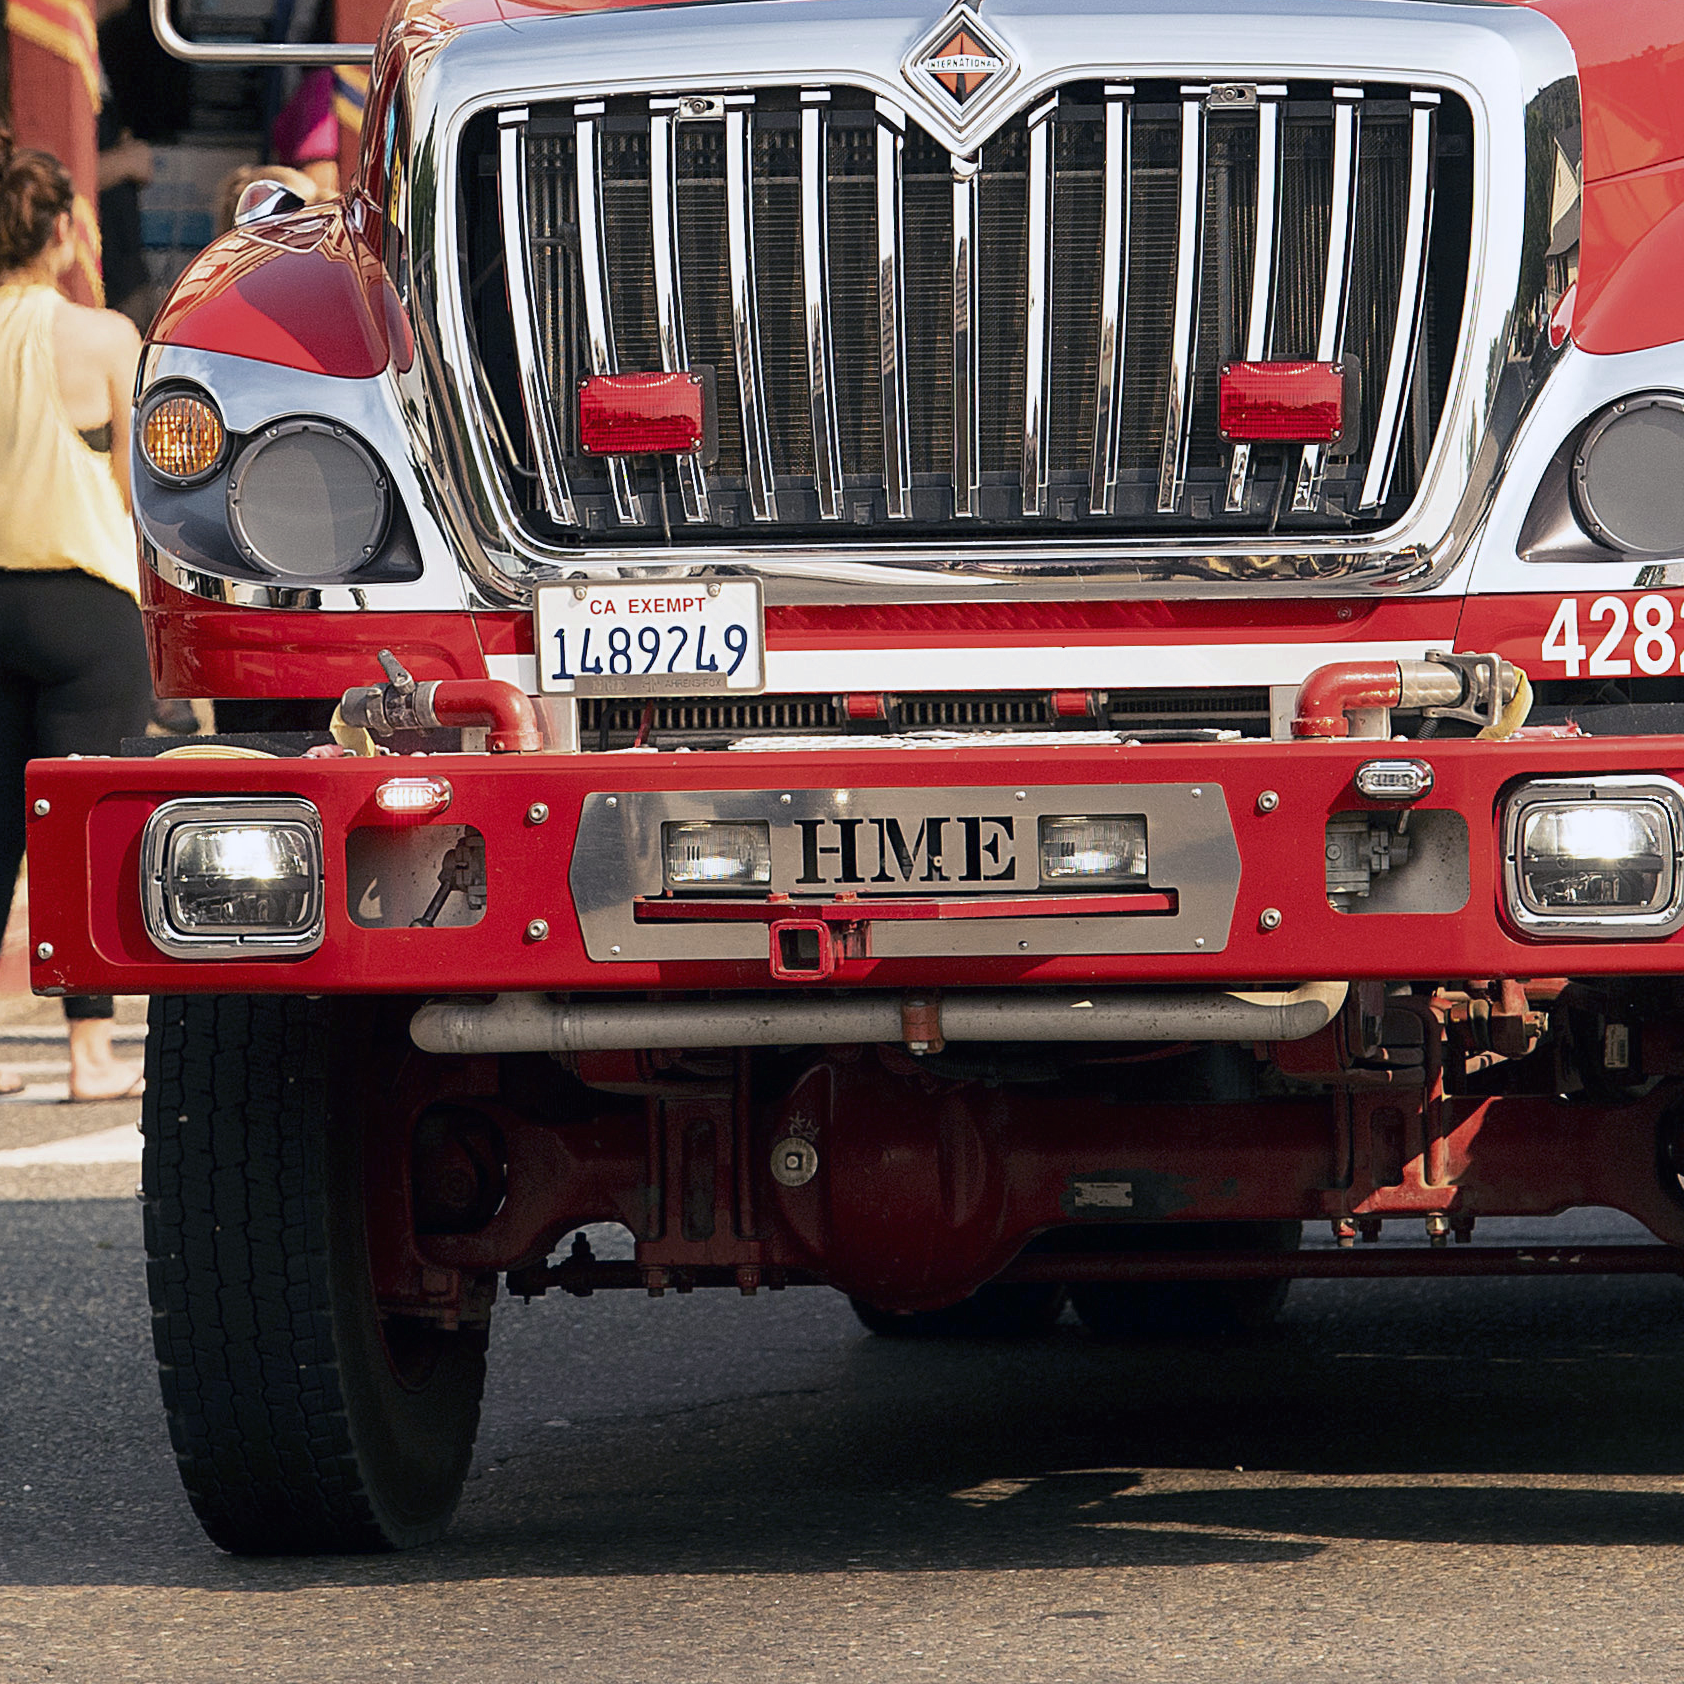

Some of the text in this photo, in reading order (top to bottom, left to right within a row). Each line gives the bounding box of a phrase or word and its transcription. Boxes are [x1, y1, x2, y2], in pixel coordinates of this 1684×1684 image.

[927, 58, 997, 68] INTERNATIONAL
[590, 597, 706, 615] CA EXEMPT
[552, 624, 748, 680] 1489249
[793, 815, 1017, 884] HME
